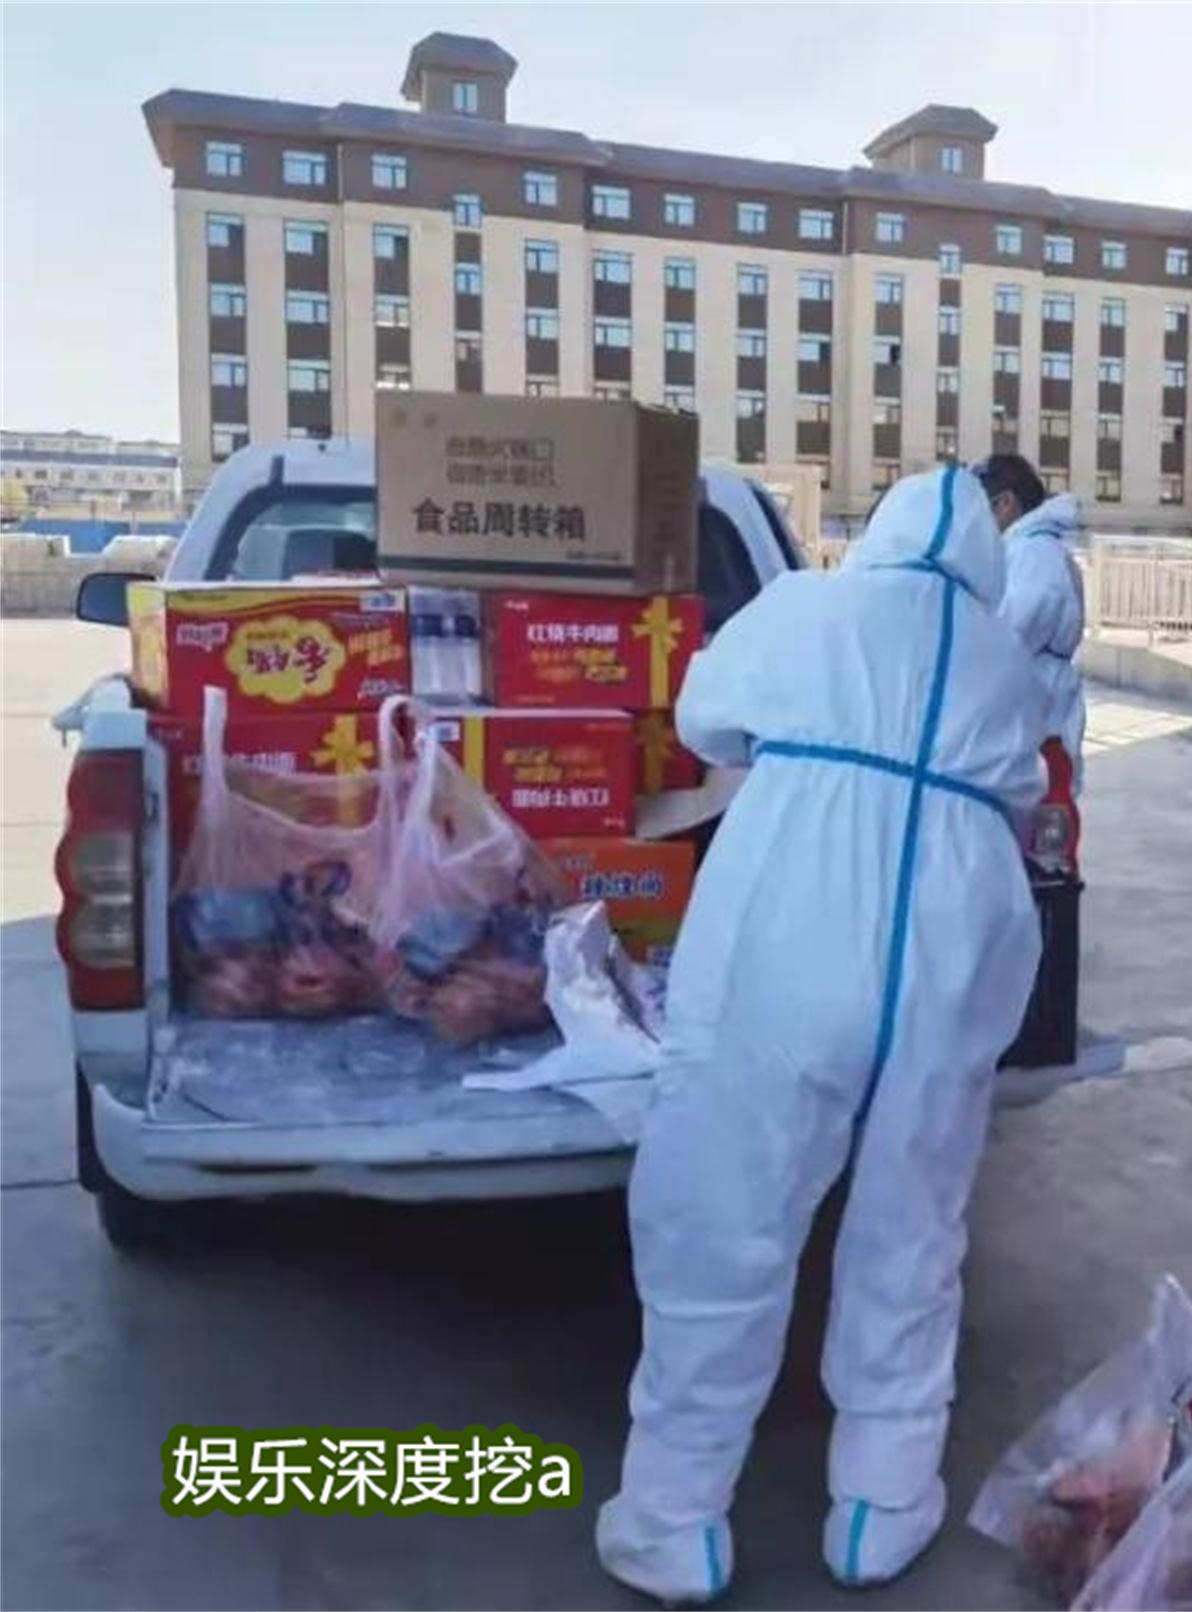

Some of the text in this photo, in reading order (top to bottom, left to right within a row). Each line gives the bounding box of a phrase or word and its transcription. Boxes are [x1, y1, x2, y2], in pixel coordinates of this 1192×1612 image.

[413, 497, 586, 543] 食品周转箱
